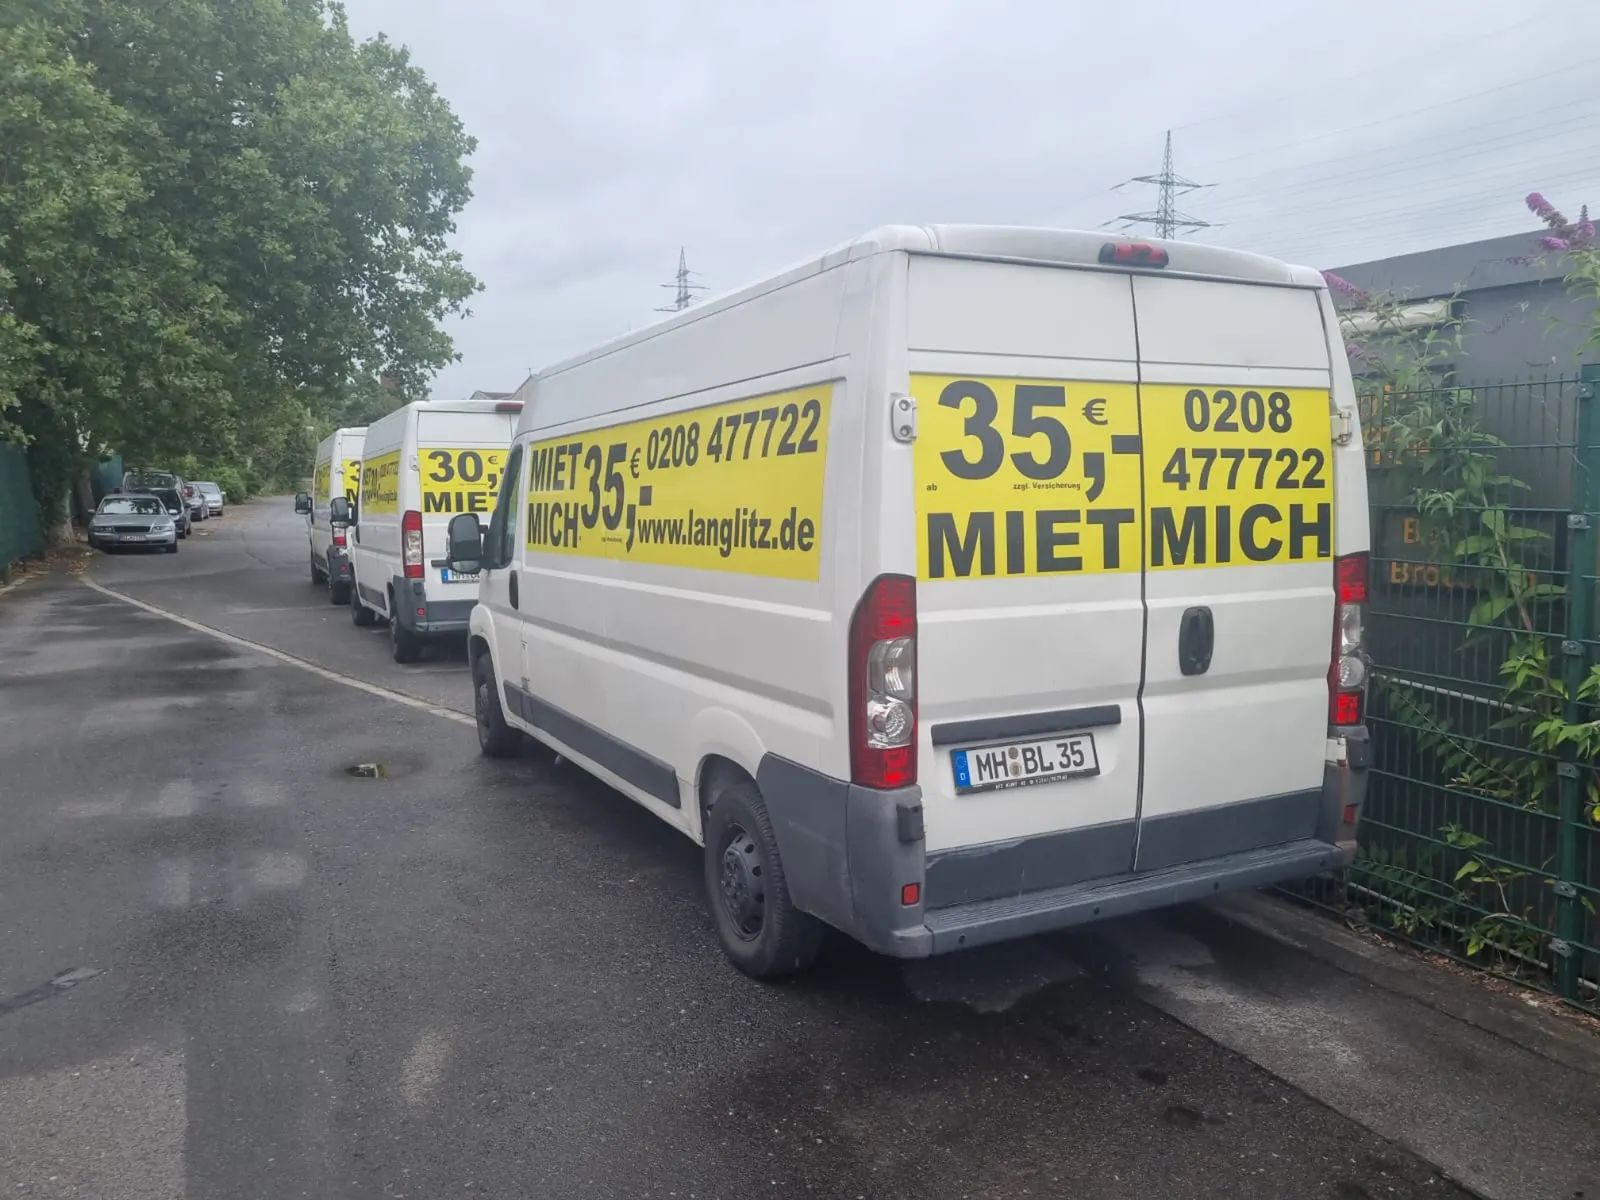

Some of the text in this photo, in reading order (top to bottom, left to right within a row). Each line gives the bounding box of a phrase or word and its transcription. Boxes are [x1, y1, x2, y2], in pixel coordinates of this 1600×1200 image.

[1081, 398, 1109, 426] €
[1184, 388, 1293, 433] 0208
[646, 399, 821, 471] 0208 477722
[529, 442, 583, 492] MIET
[629, 447, 641, 479] €
[1162, 447, 1326, 491] 477722
[925, 481, 938, 491] ab
[1012, 481, 1081, 491] zzgl. Versicherung
[527, 501, 579, 549] MICH
[637, 506, 815, 558] www.langlitz.de
[927, 508, 1136, 579] MIET
[1150, 502, 1332, 567] MICH
[960, 772, 966, 781] D
[975, 740, 1085, 781] MH BL 35
